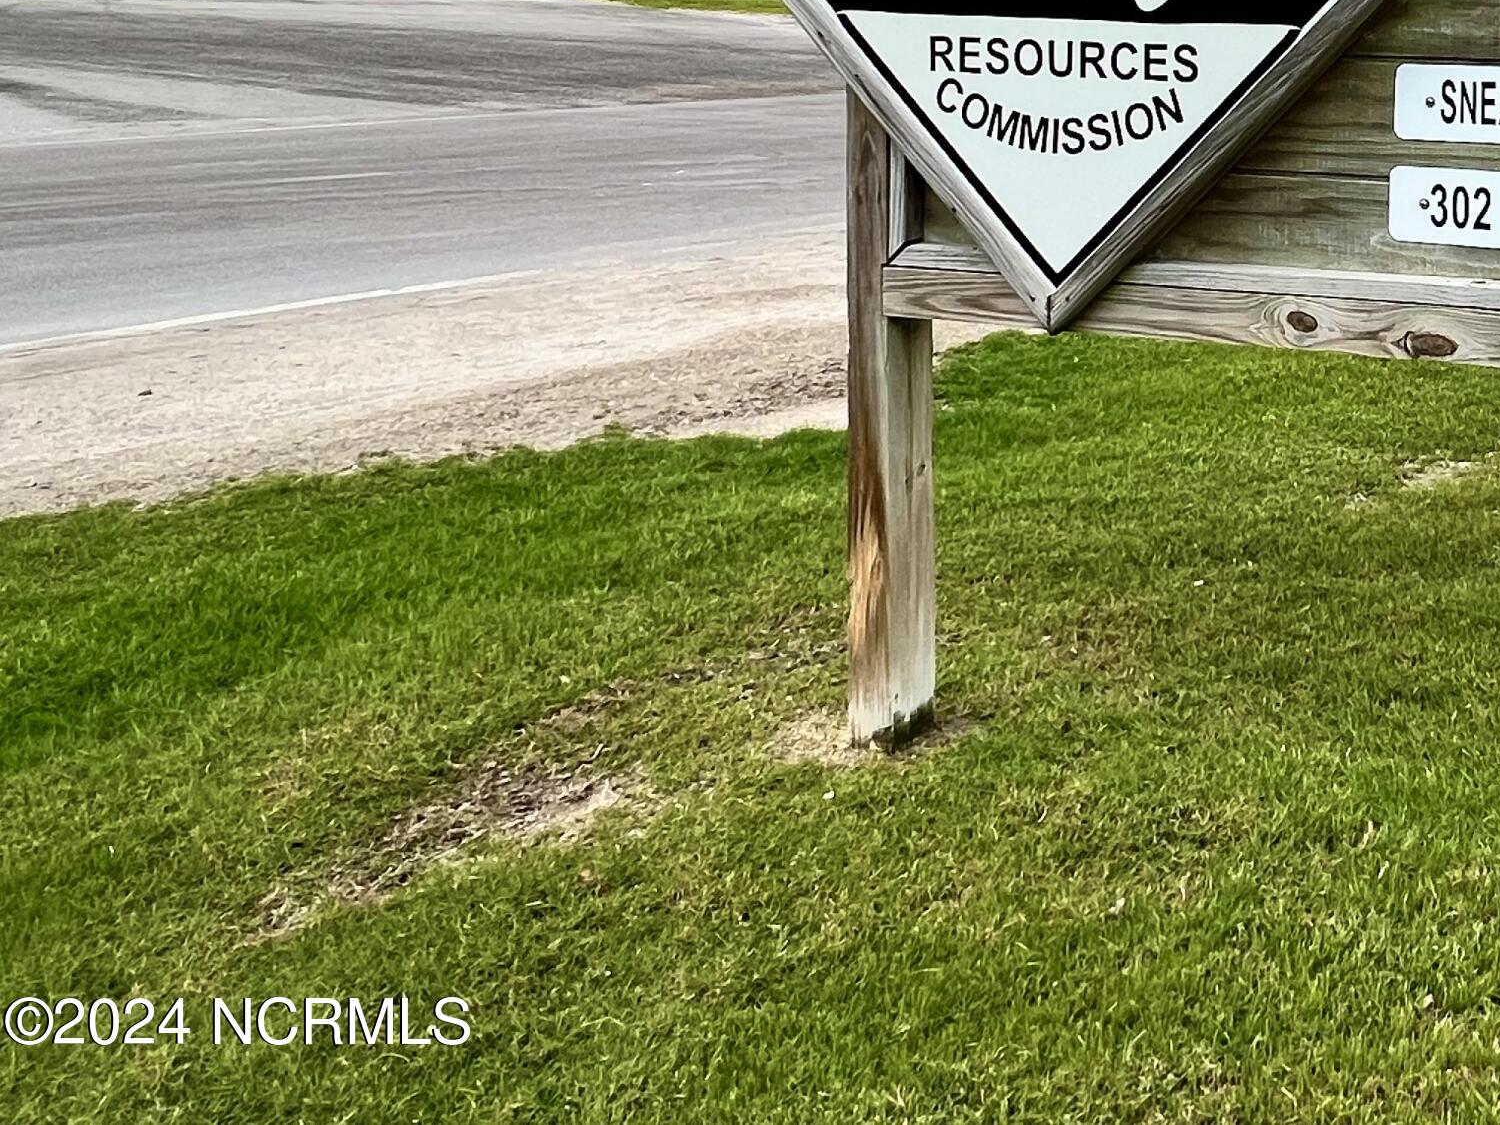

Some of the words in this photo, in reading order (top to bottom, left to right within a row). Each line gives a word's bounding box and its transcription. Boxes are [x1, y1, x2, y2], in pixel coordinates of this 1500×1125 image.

[930, 36, 1198, 83] RESOURCES
[936, 79, 1186, 156] COMMISSION
[1430, 184, 1490, 230] 302
